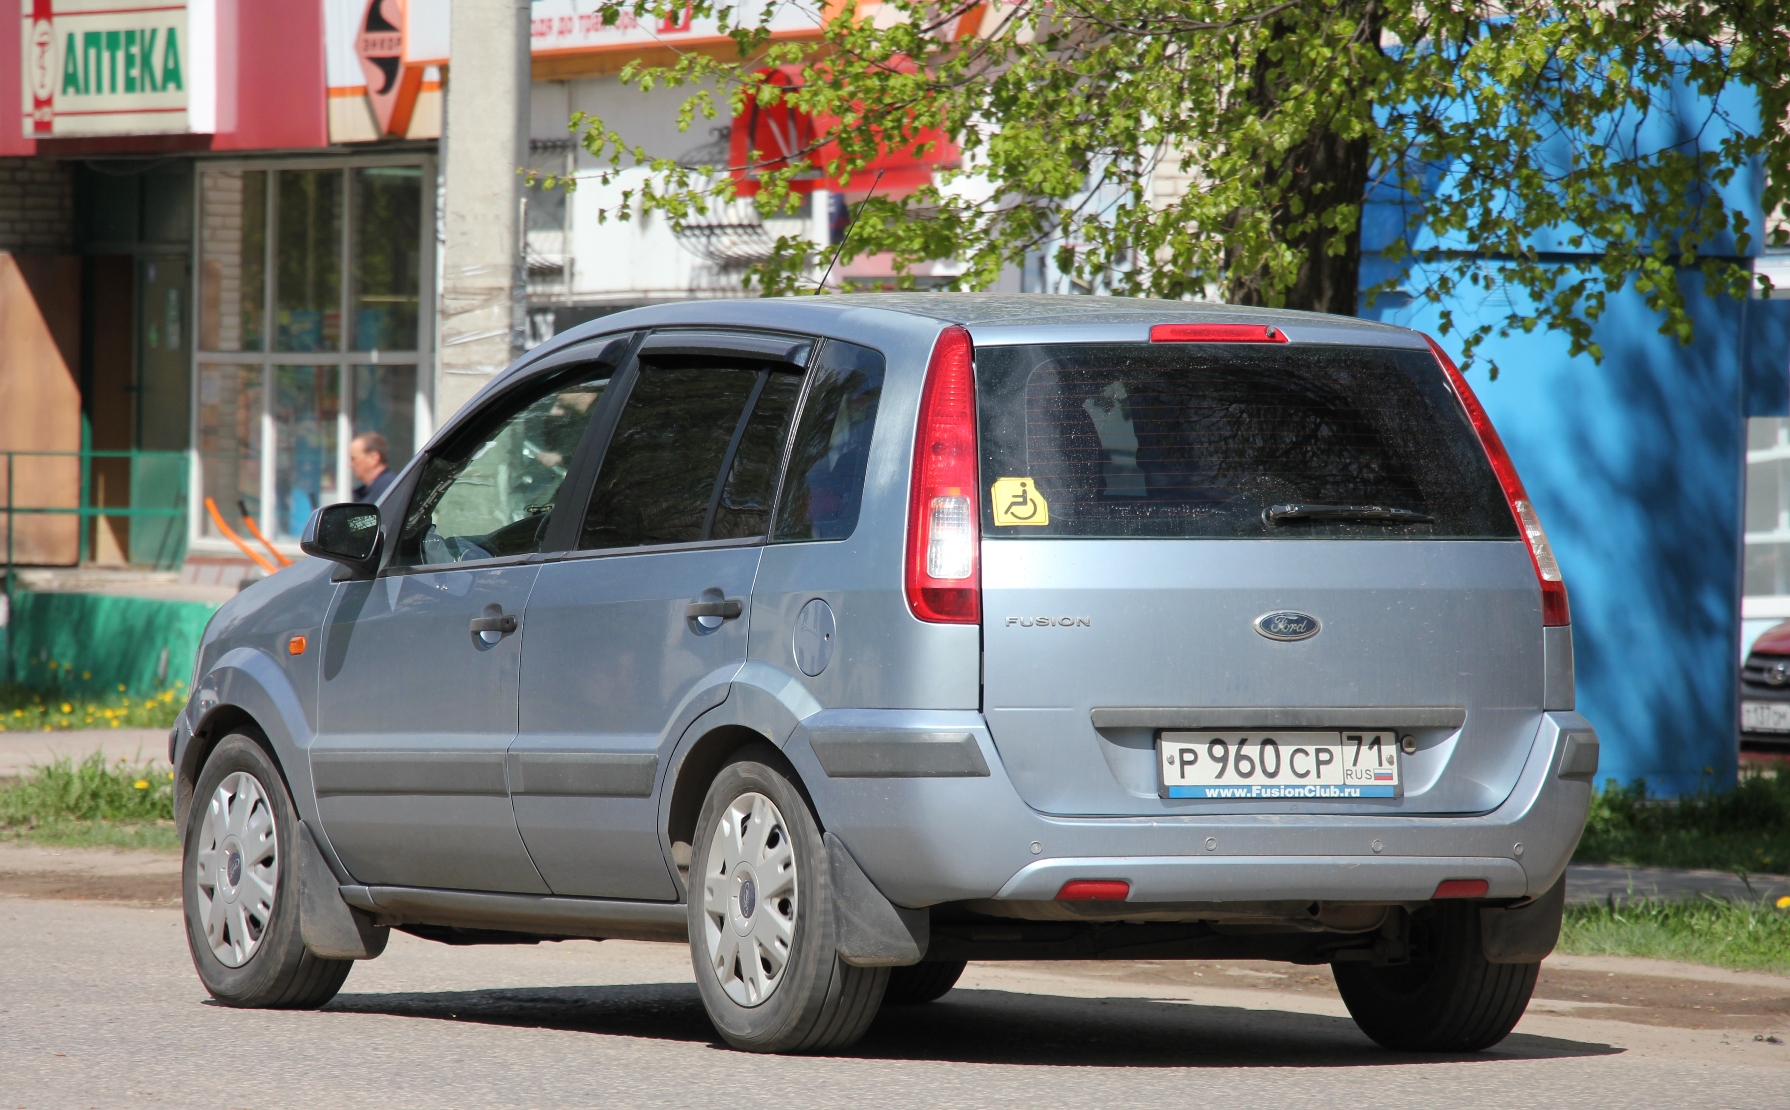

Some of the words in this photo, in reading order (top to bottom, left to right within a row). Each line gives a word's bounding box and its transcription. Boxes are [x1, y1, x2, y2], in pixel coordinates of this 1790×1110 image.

[579, 12, 638, 38] траора
[62, 27, 184, 96] АПТЕКА
[1005, 616, 1091, 627] FUSION
[1270, 615, 1308, 632] Ford
[1346, 735, 1383, 767] 71
[1346, 769, 1373, 780] RUS
[1205, 785, 1361, 798] www.FusionClub.ru
